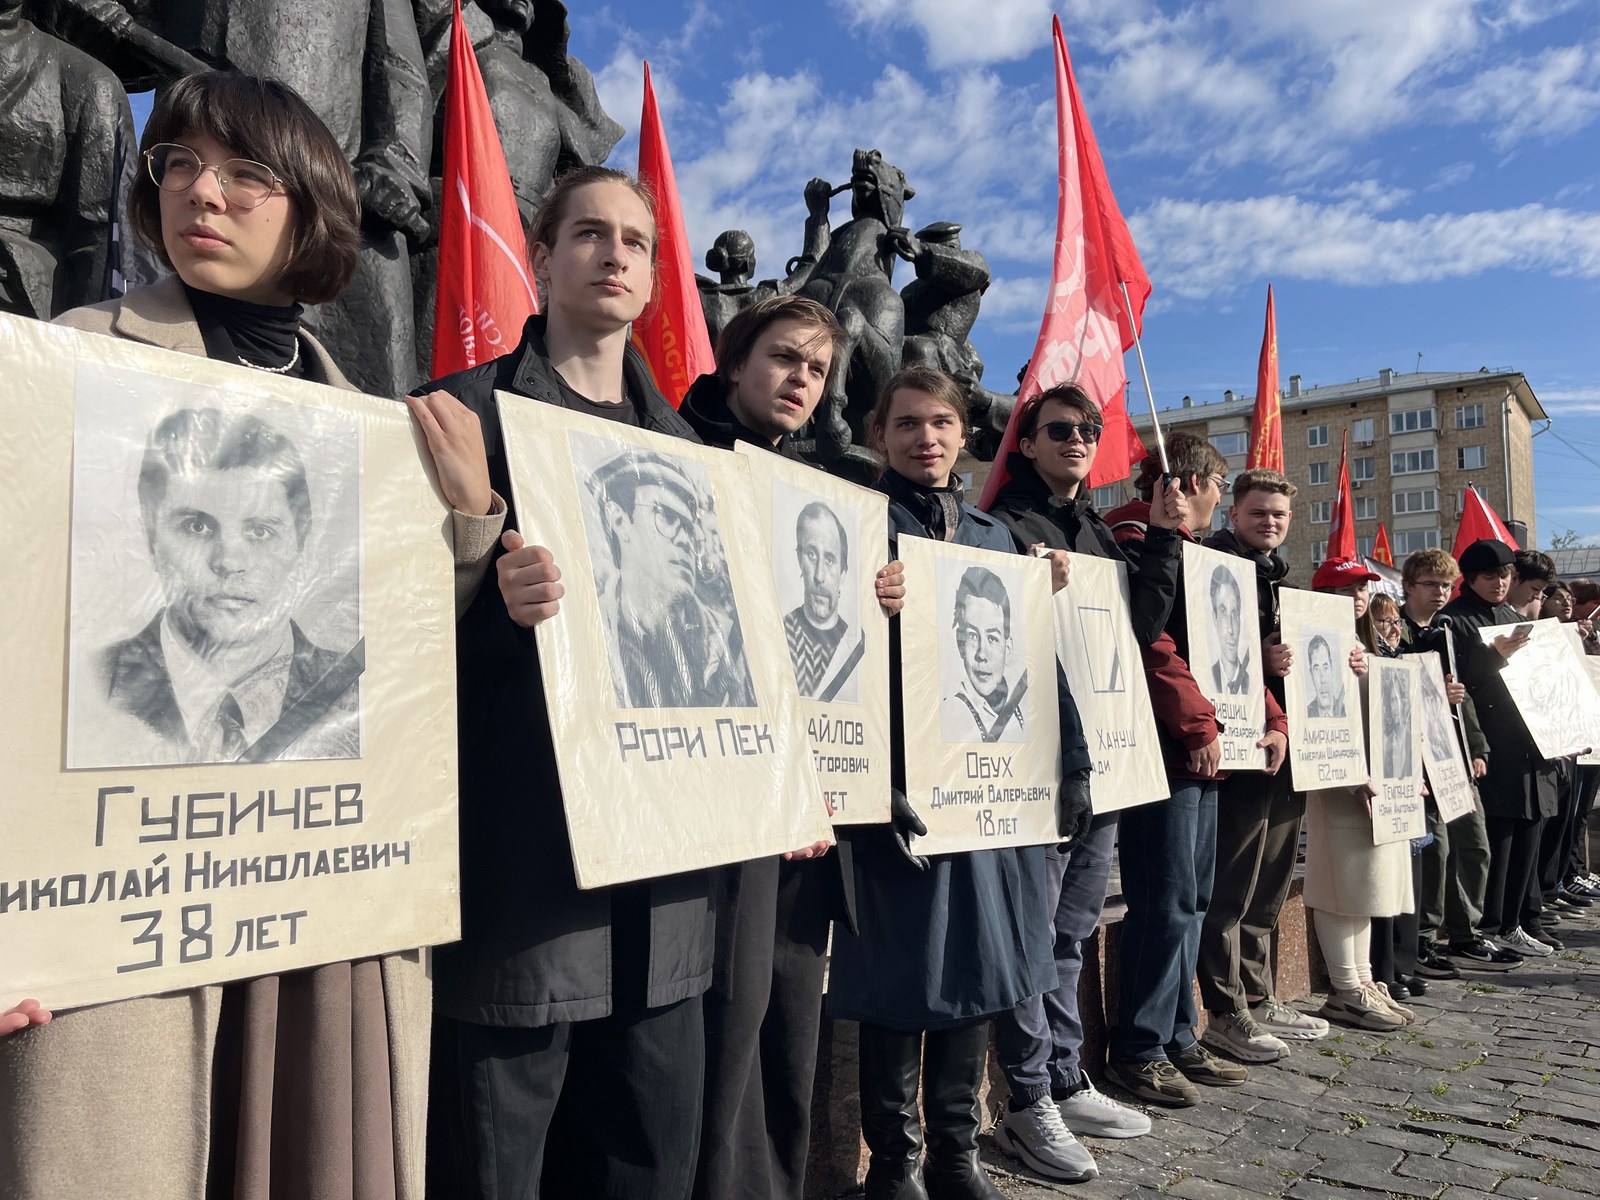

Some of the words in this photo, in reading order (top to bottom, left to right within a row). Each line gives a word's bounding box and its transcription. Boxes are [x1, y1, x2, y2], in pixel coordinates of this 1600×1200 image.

[614, 721, 708, 763] РОРИ
[714, 717, 776, 757] ПЕК
[807, 713, 864, 746] АЙЛОВ
[1095, 727, 1137, 751] ХАНУШ
[1302, 727, 1351, 745] АМИРХАНОВ
[812, 749, 869, 774] ГОРОВИЧ
[1222, 741, 1236, 761] 60
[965, 751, 1014, 779] ОБУХ
[1091, 759, 1111, 776] АДИ
[1317, 763, 1332, 781] 62
[930, 784, 984, 810] ДМИТРИЙ
[988, 786, 1051, 804] ВАЛЕРЬЕВИЧ
[94, 782, 365, 848] ГУБИЧЕВ
[975, 808, 995, 837] 18
[996, 817, 1018, 836] ЛЕТ
[0, 852, 170, 914] ИКОЛАЙ
[184, 840, 411, 893] НИКОЛАЕВИЧ
[116, 902, 214, 974] 38
[224, 910, 308, 958] ЛЕТ
